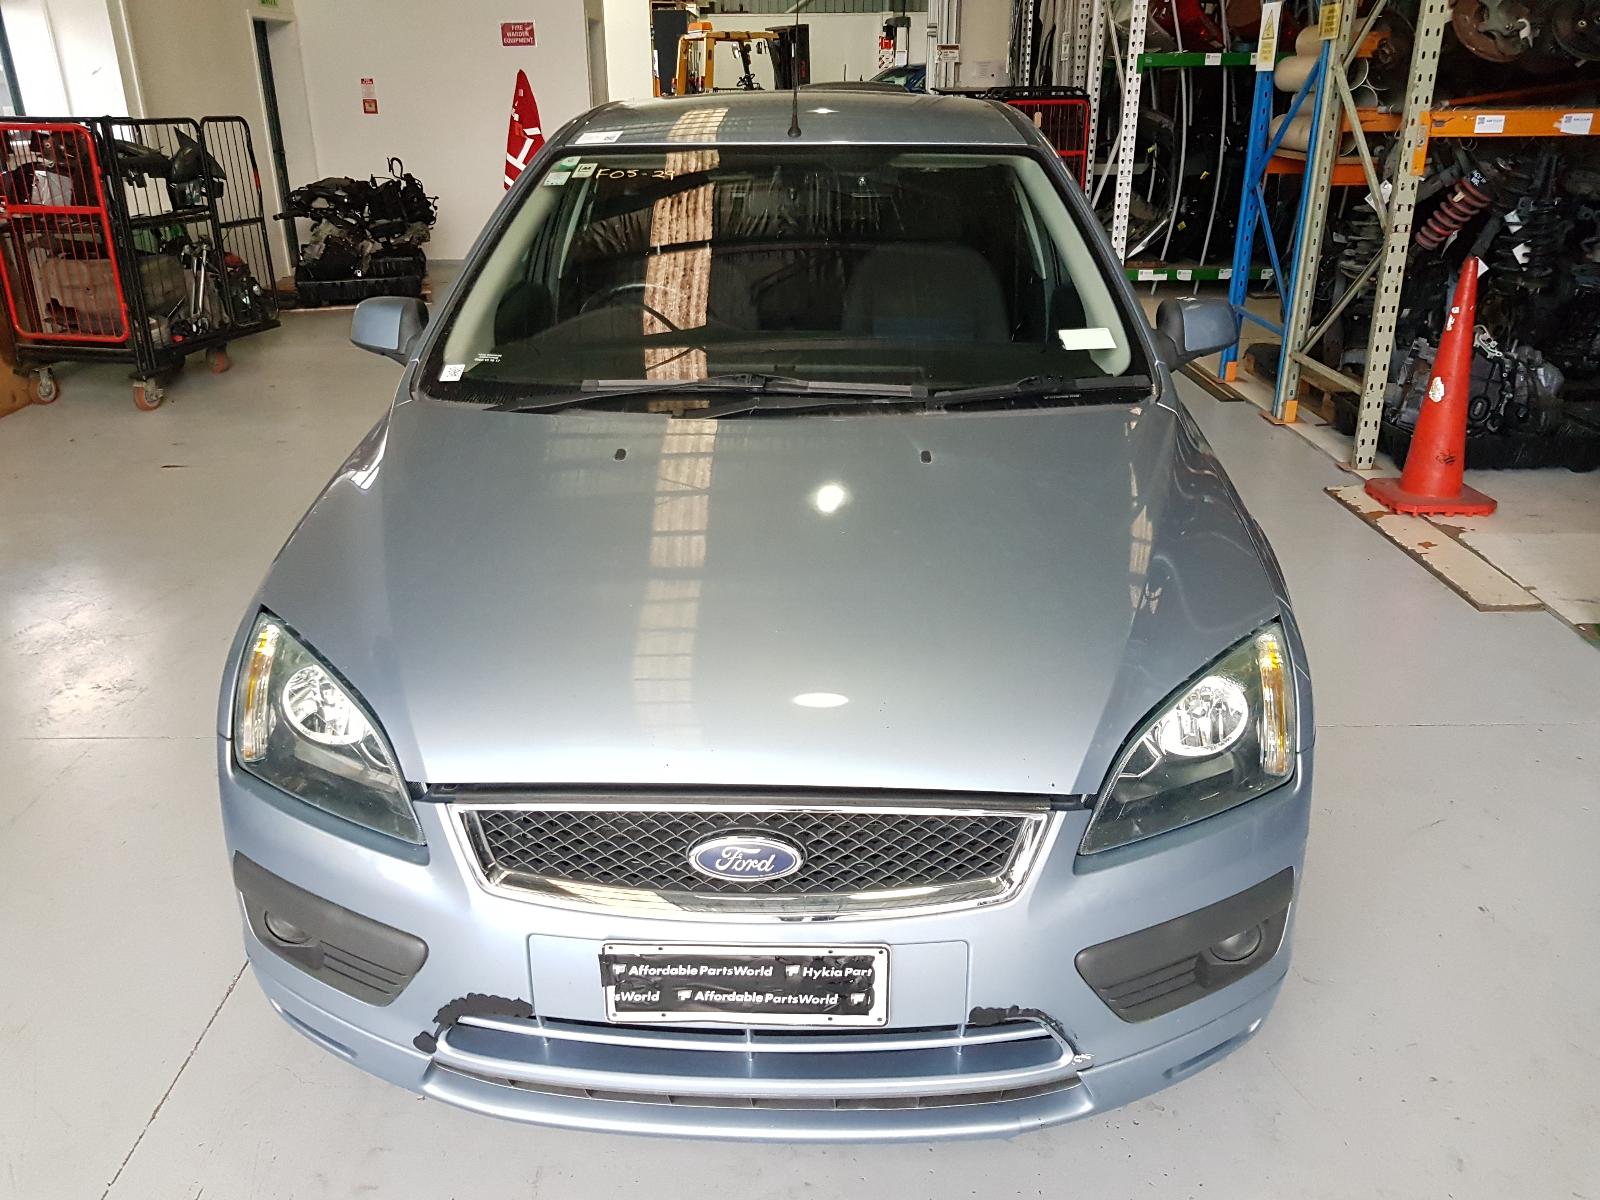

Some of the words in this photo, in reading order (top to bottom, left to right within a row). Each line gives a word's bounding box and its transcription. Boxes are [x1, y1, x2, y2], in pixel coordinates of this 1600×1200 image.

[715, 846, 776, 872] Ford
[628, 964, 698, 976] Affordable
[699, 965, 774, 977] PartsWorld
[803, 966, 843, 980] Hykia
[694, 991, 764, 1003] Affordable
[764, 993, 840, 1005] PartsWorld
